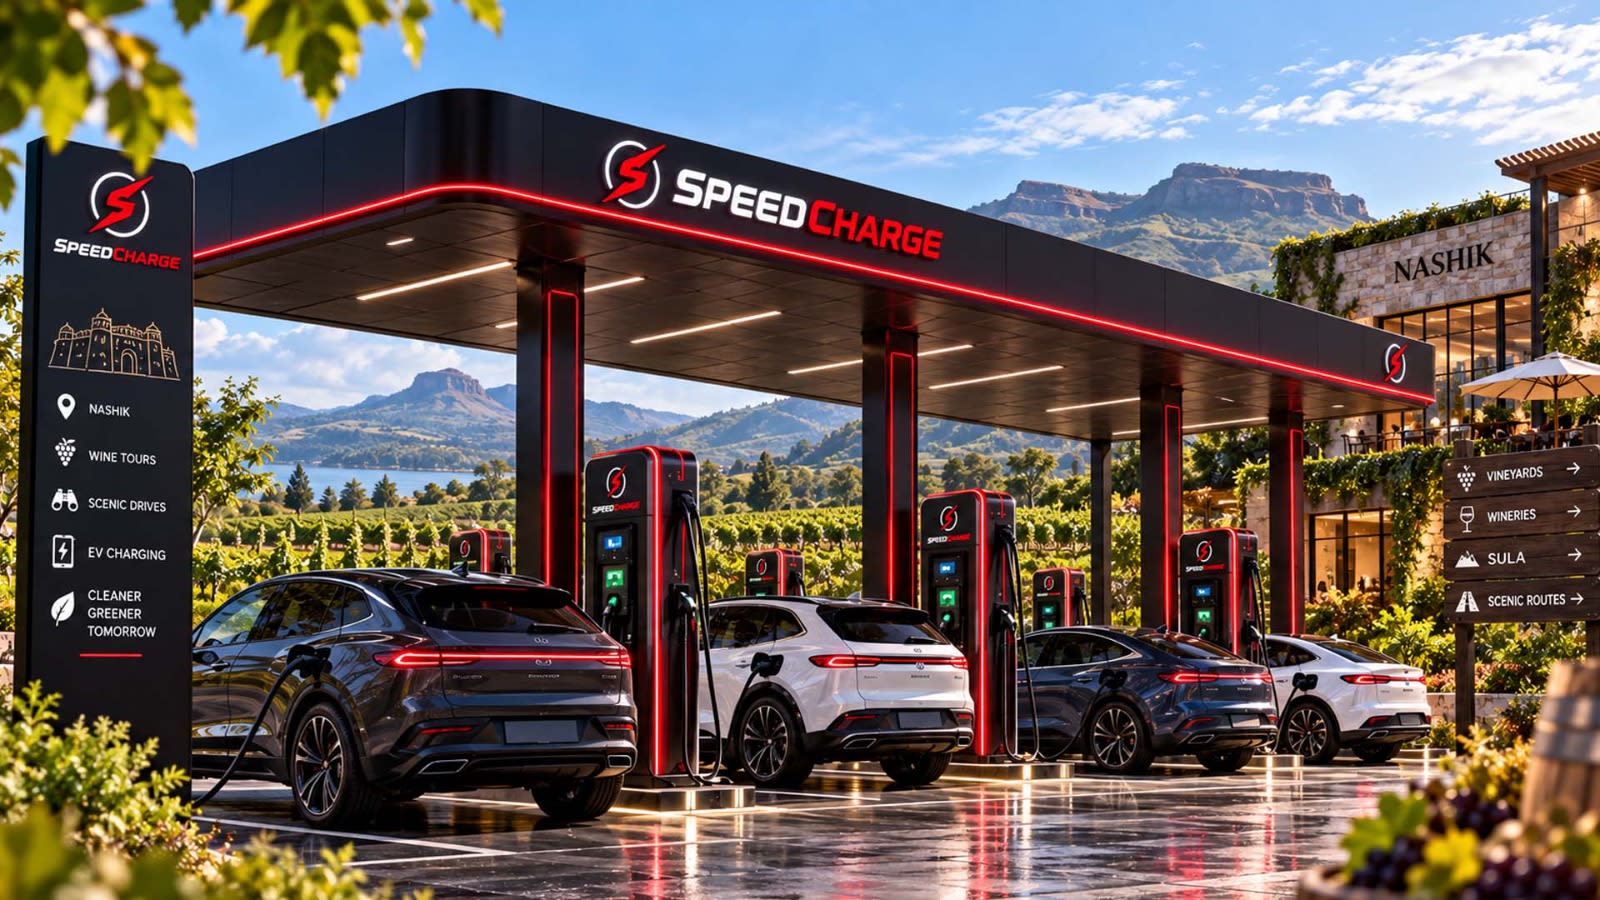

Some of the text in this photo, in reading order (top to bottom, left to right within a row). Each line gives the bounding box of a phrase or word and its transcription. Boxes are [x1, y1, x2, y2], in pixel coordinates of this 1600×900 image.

[672, 168, 944, 259] SPEEDCHARGE
[53, 238, 181, 270] SPEEDCHARGE
[1394, 241, 1494, 283] NASHIK
[89, 403, 130, 417] NASHIK
[88, 450, 156, 465] WINE TOURS
[1487, 466, 1543, 482] VINEYARDS
[88, 498, 167, 513] SCENIC DRIVES
[1487, 509, 1537, 522] WINERIES
[88, 547, 166, 561] EV CHARGING
[1487, 551, 1526, 565] SULA
[87, 589, 142, 602] CLEANER
[1488, 593, 1566, 607] SCENIC ROUTES
[87, 607, 142, 620] GREENER
[87, 625, 157, 638] TOMORROW
